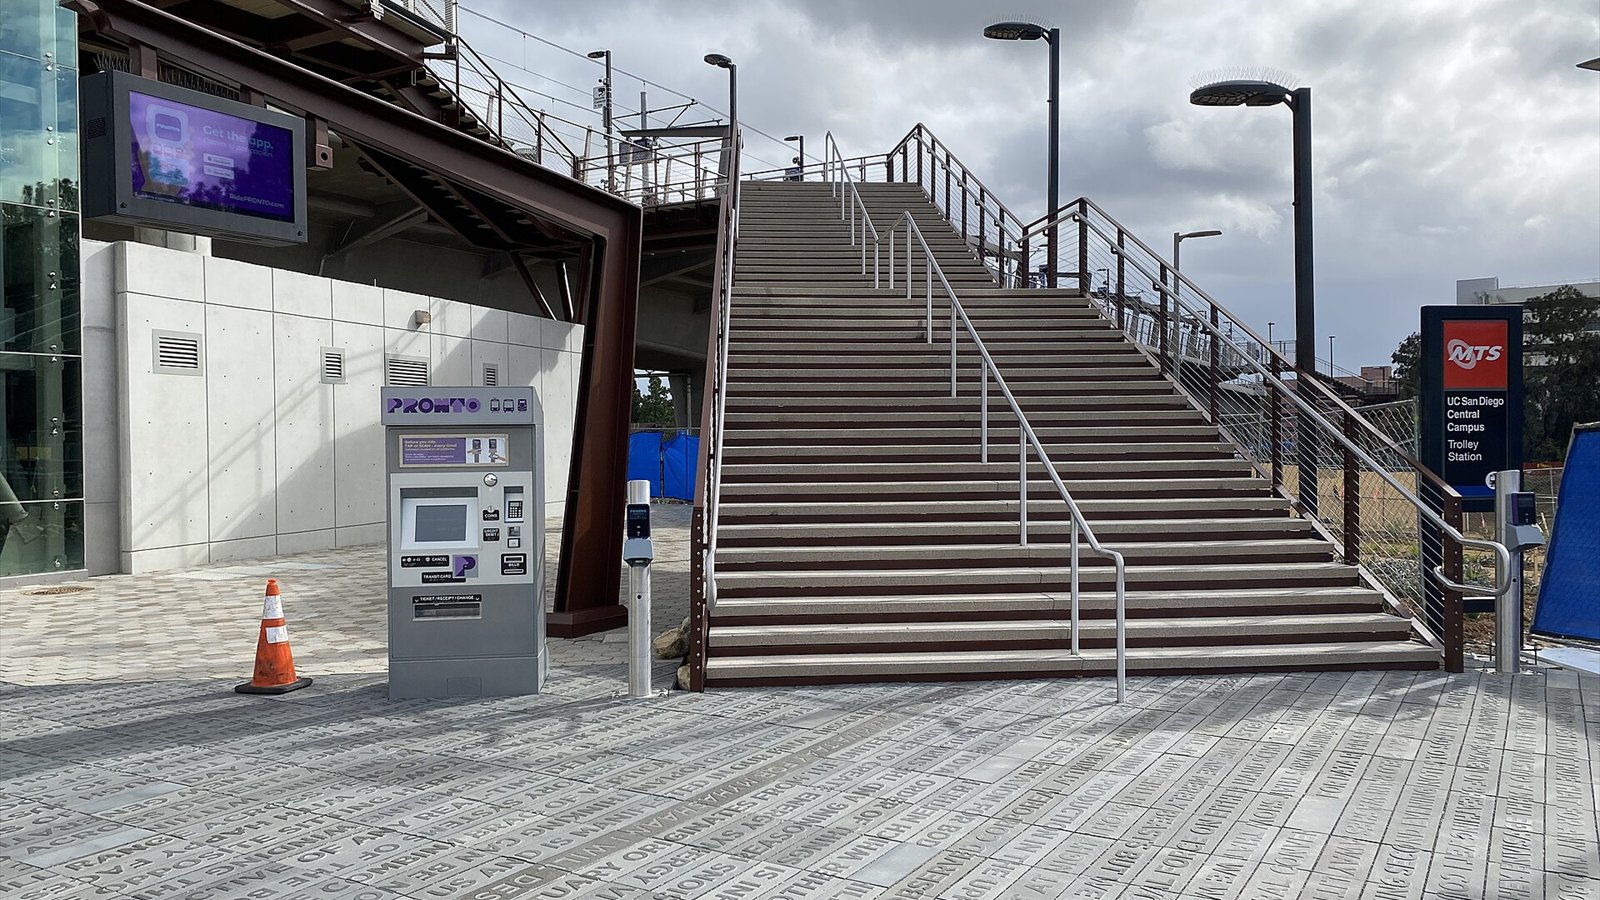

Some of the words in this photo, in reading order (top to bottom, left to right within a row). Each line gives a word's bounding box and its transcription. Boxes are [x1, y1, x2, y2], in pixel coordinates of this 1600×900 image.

[203, 125, 224, 138] Get
[226, 130, 247, 142] the
[248, 138, 274, 150] app.
[1447, 344, 1503, 362] MTS
[387, 397, 481, 413] PRONTO
[1447, 397, 1461, 406] UC
[1461, 397, 1478, 406] San
[1479, 397, 1504, 408] Diego
[1447, 410, 1480, 419] Central
[1447, 423, 1485, 433] Campus
[1448, 440, 1479, 451] Trolley
[1448, 452, 1483, 461] Station
